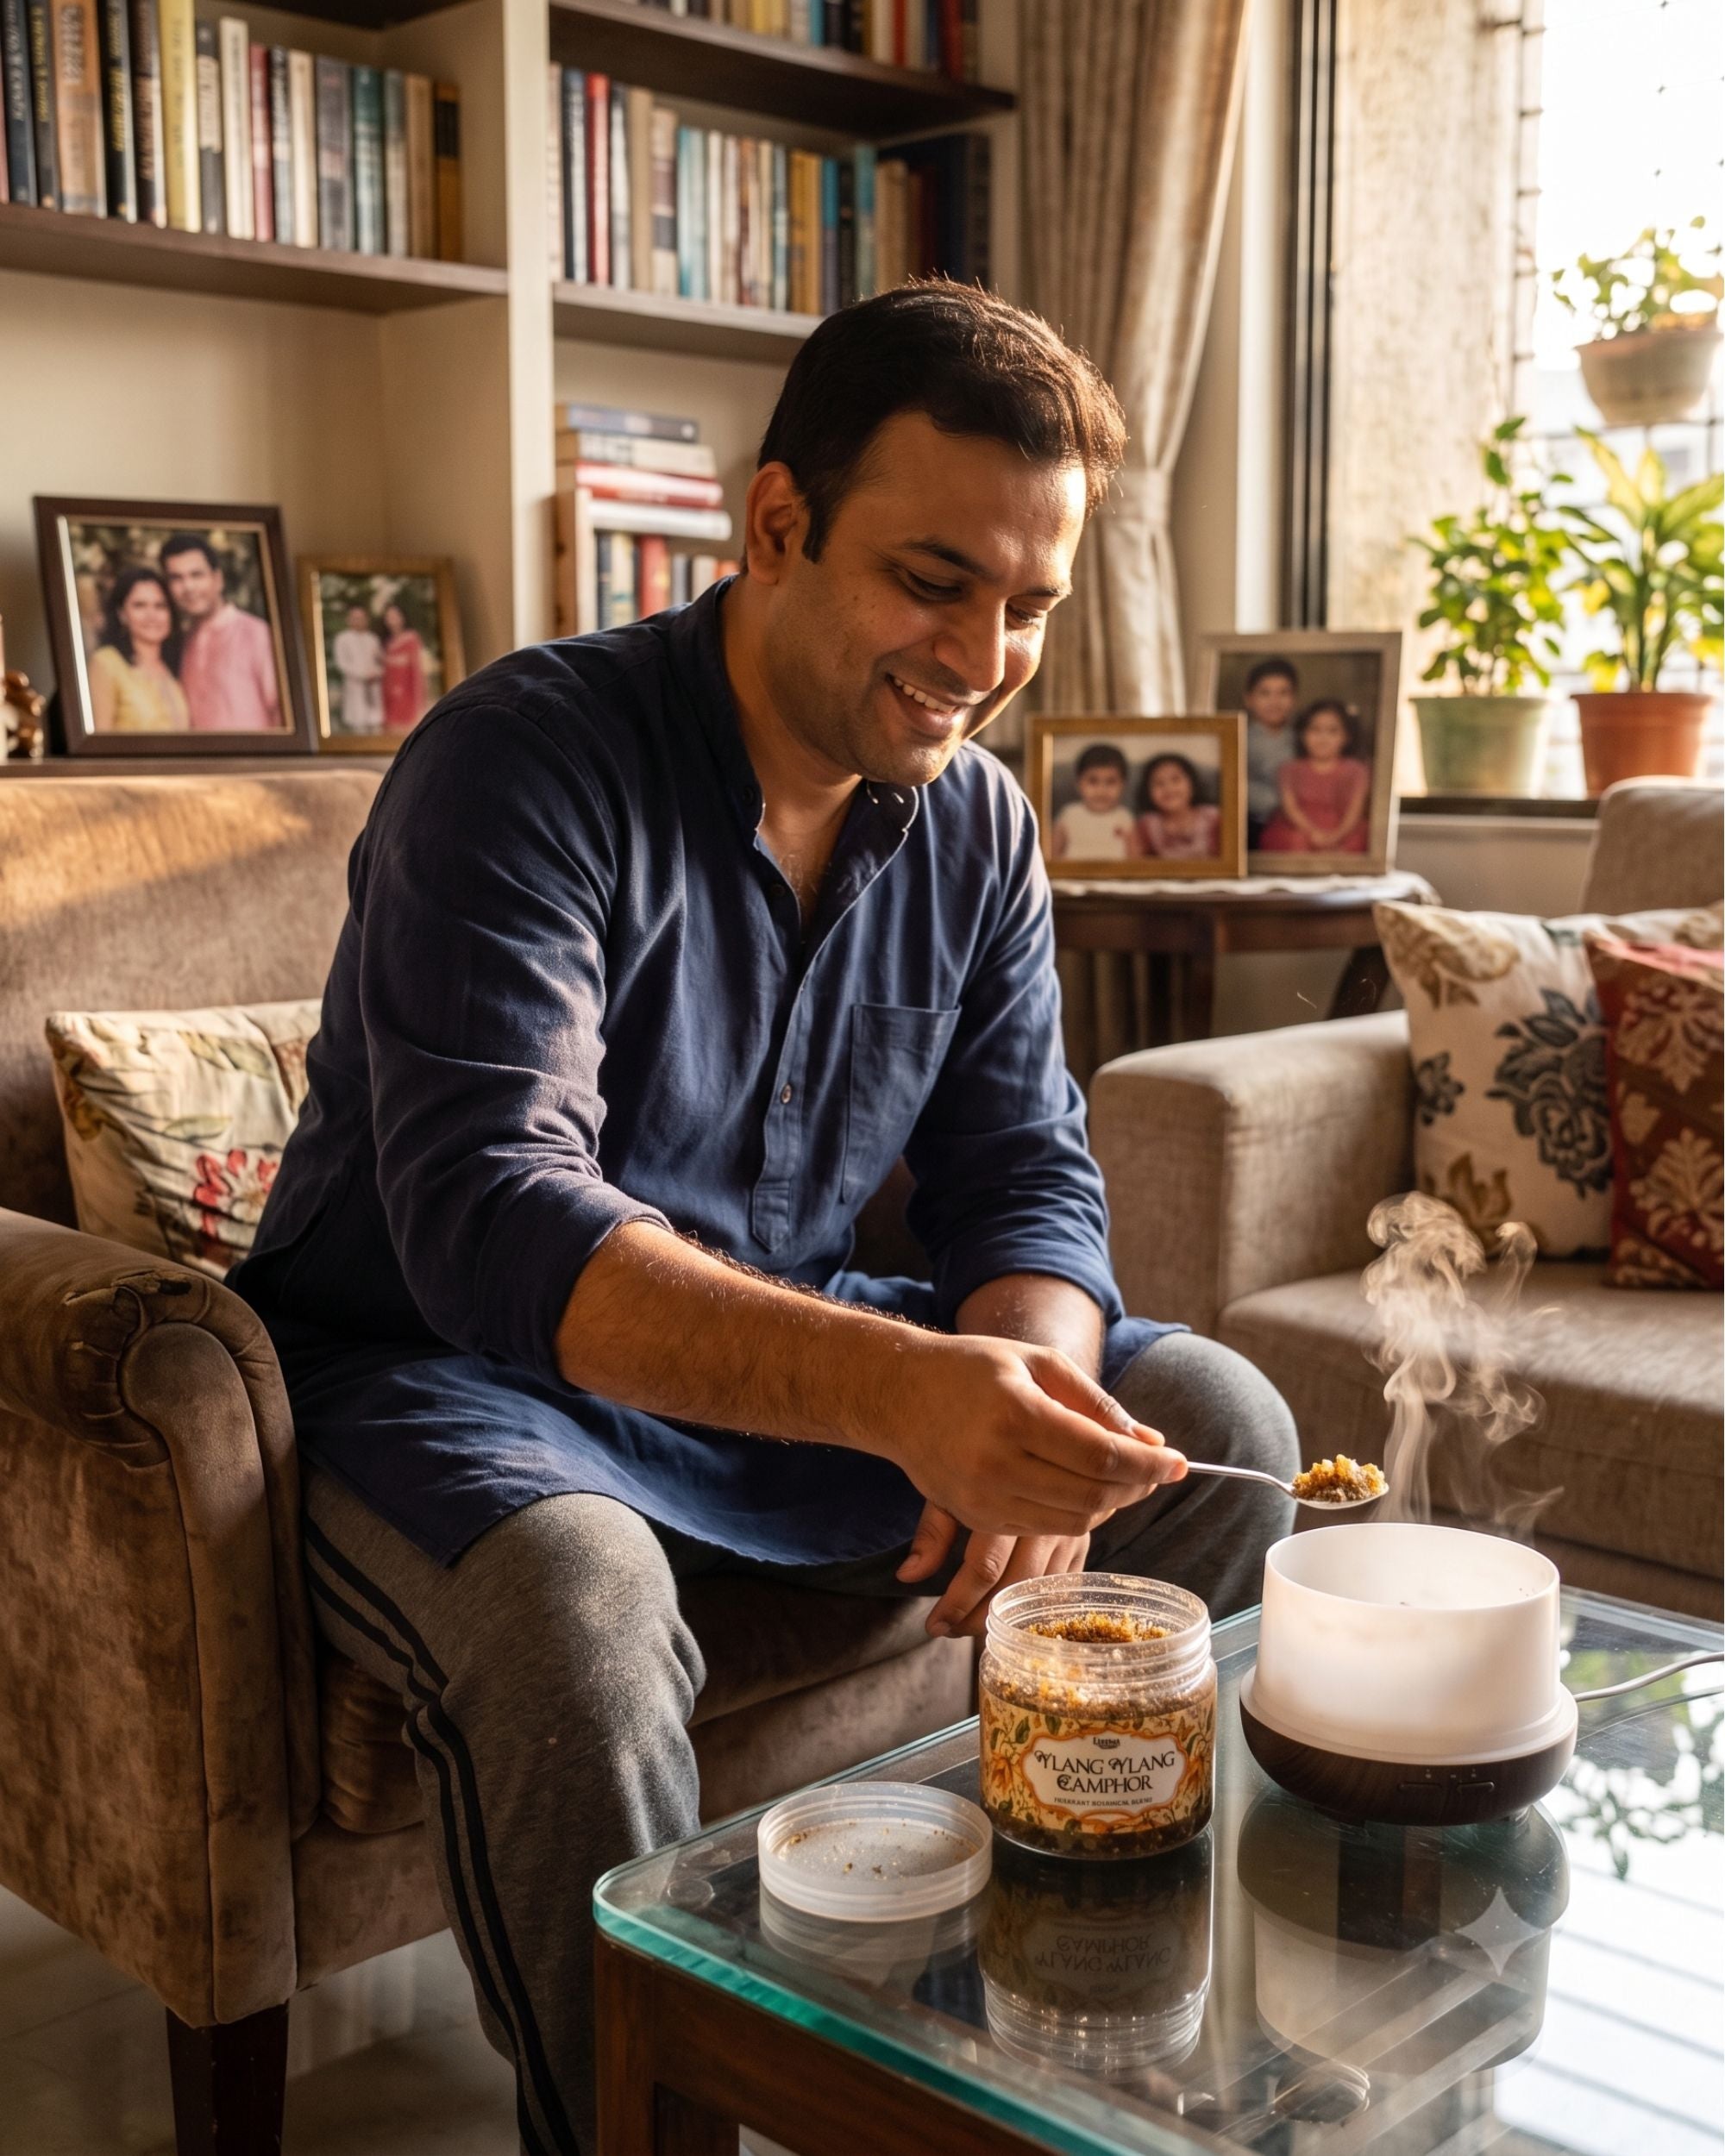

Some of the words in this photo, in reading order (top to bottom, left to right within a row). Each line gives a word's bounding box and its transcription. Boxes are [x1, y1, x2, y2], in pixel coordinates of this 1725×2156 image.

[1034, 1750, 1105, 1775] YLANG
[1108, 1751, 1176, 1775] YLANG
[1057, 1774, 1153, 1794] CAMPHOR
